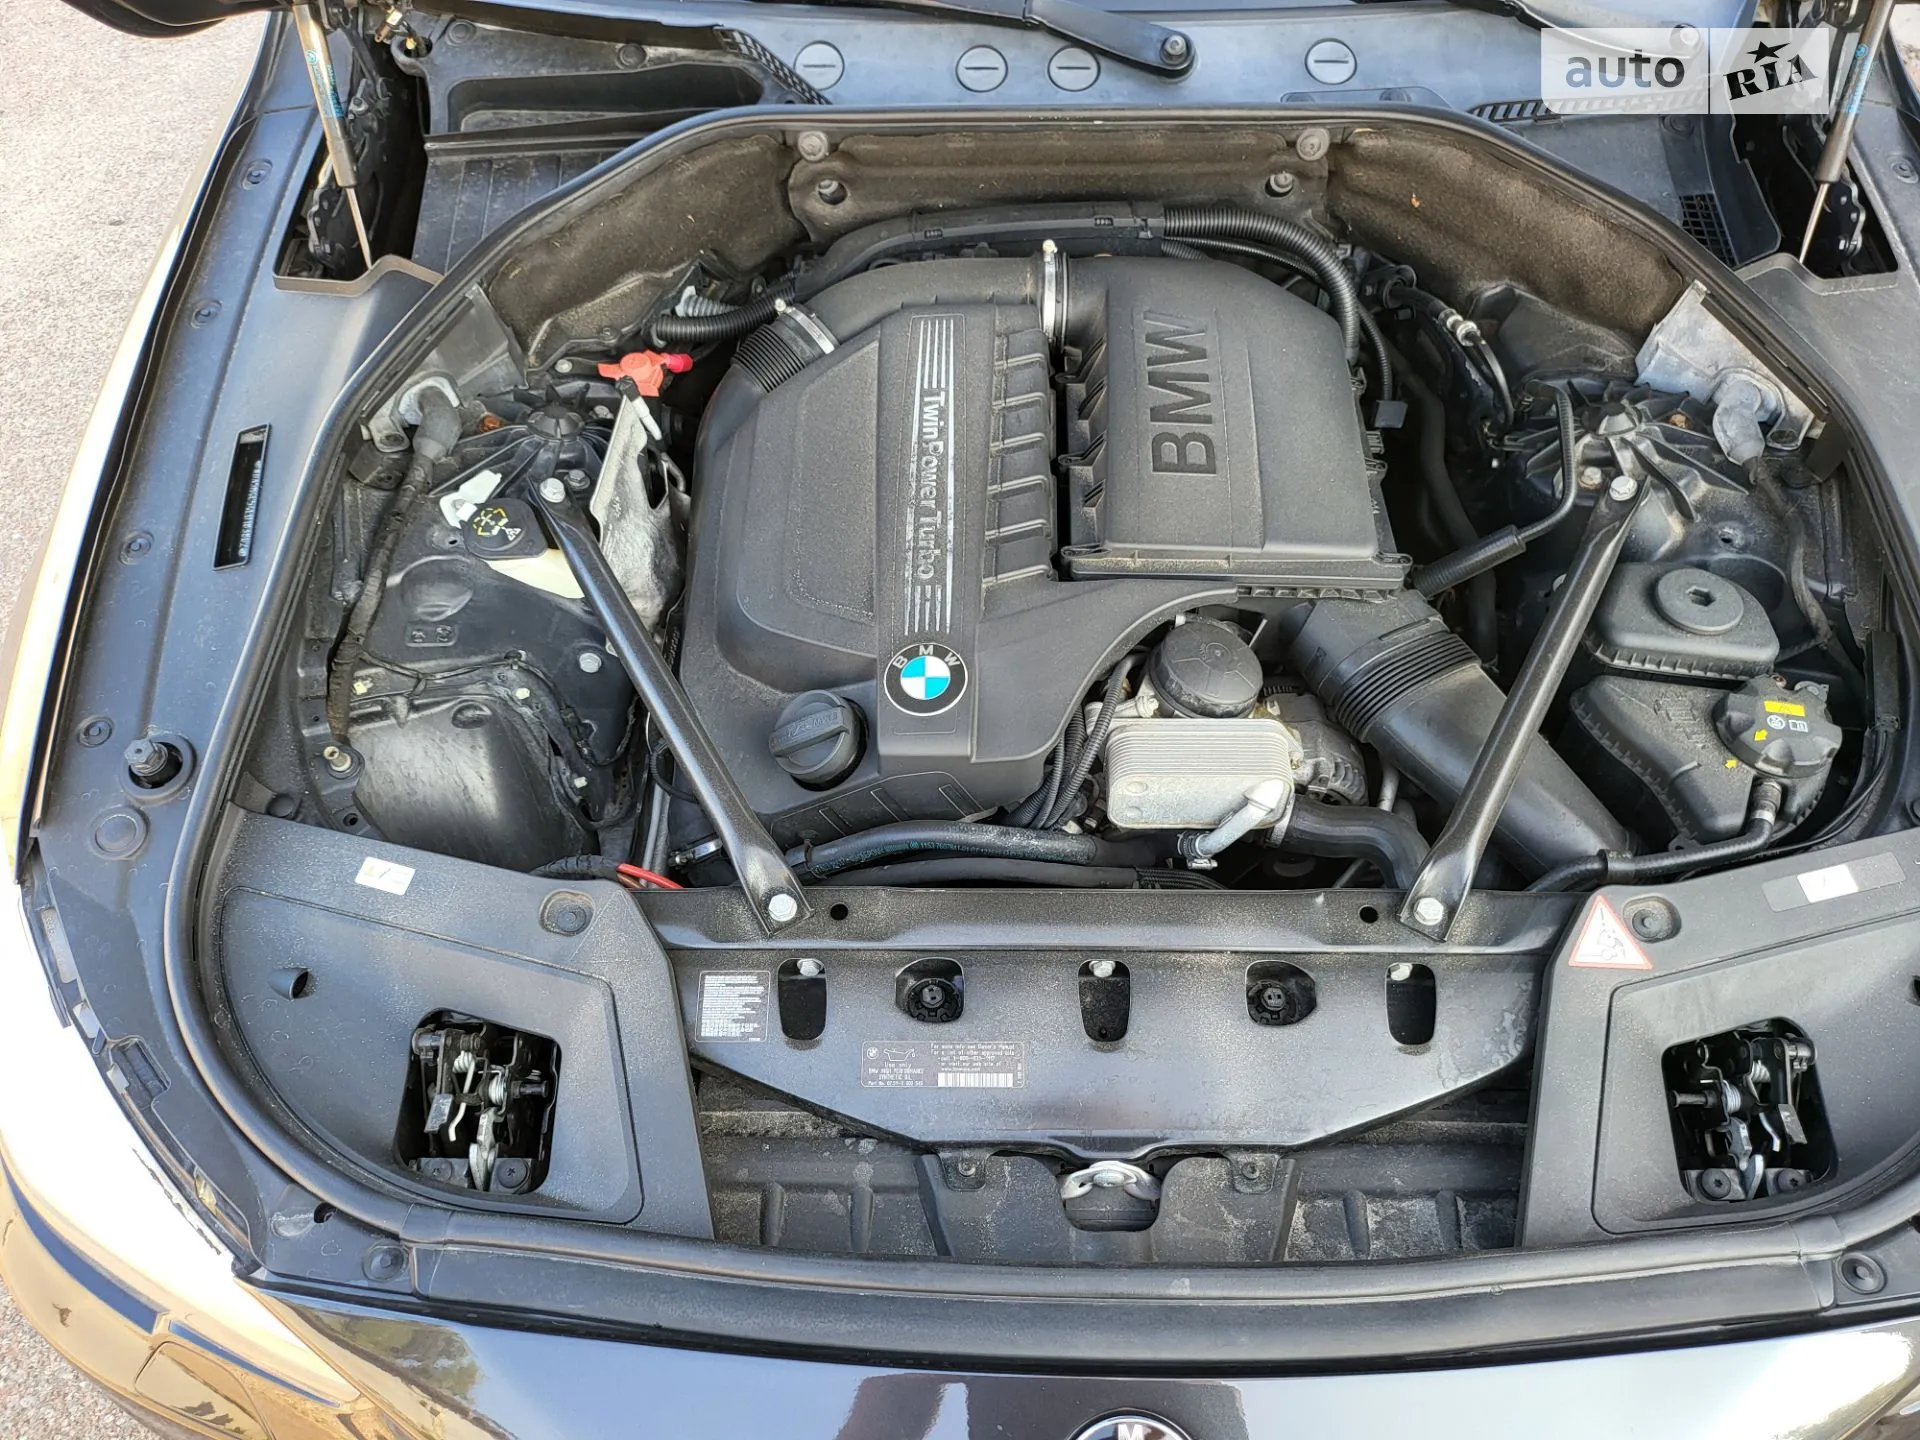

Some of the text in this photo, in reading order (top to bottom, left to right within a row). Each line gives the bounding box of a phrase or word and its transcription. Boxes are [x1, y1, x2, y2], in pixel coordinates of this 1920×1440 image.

[1143, 309, 1217, 475] BMW
[916, 510, 943, 581] Turbo
[892, 644, 961, 669] BMW
